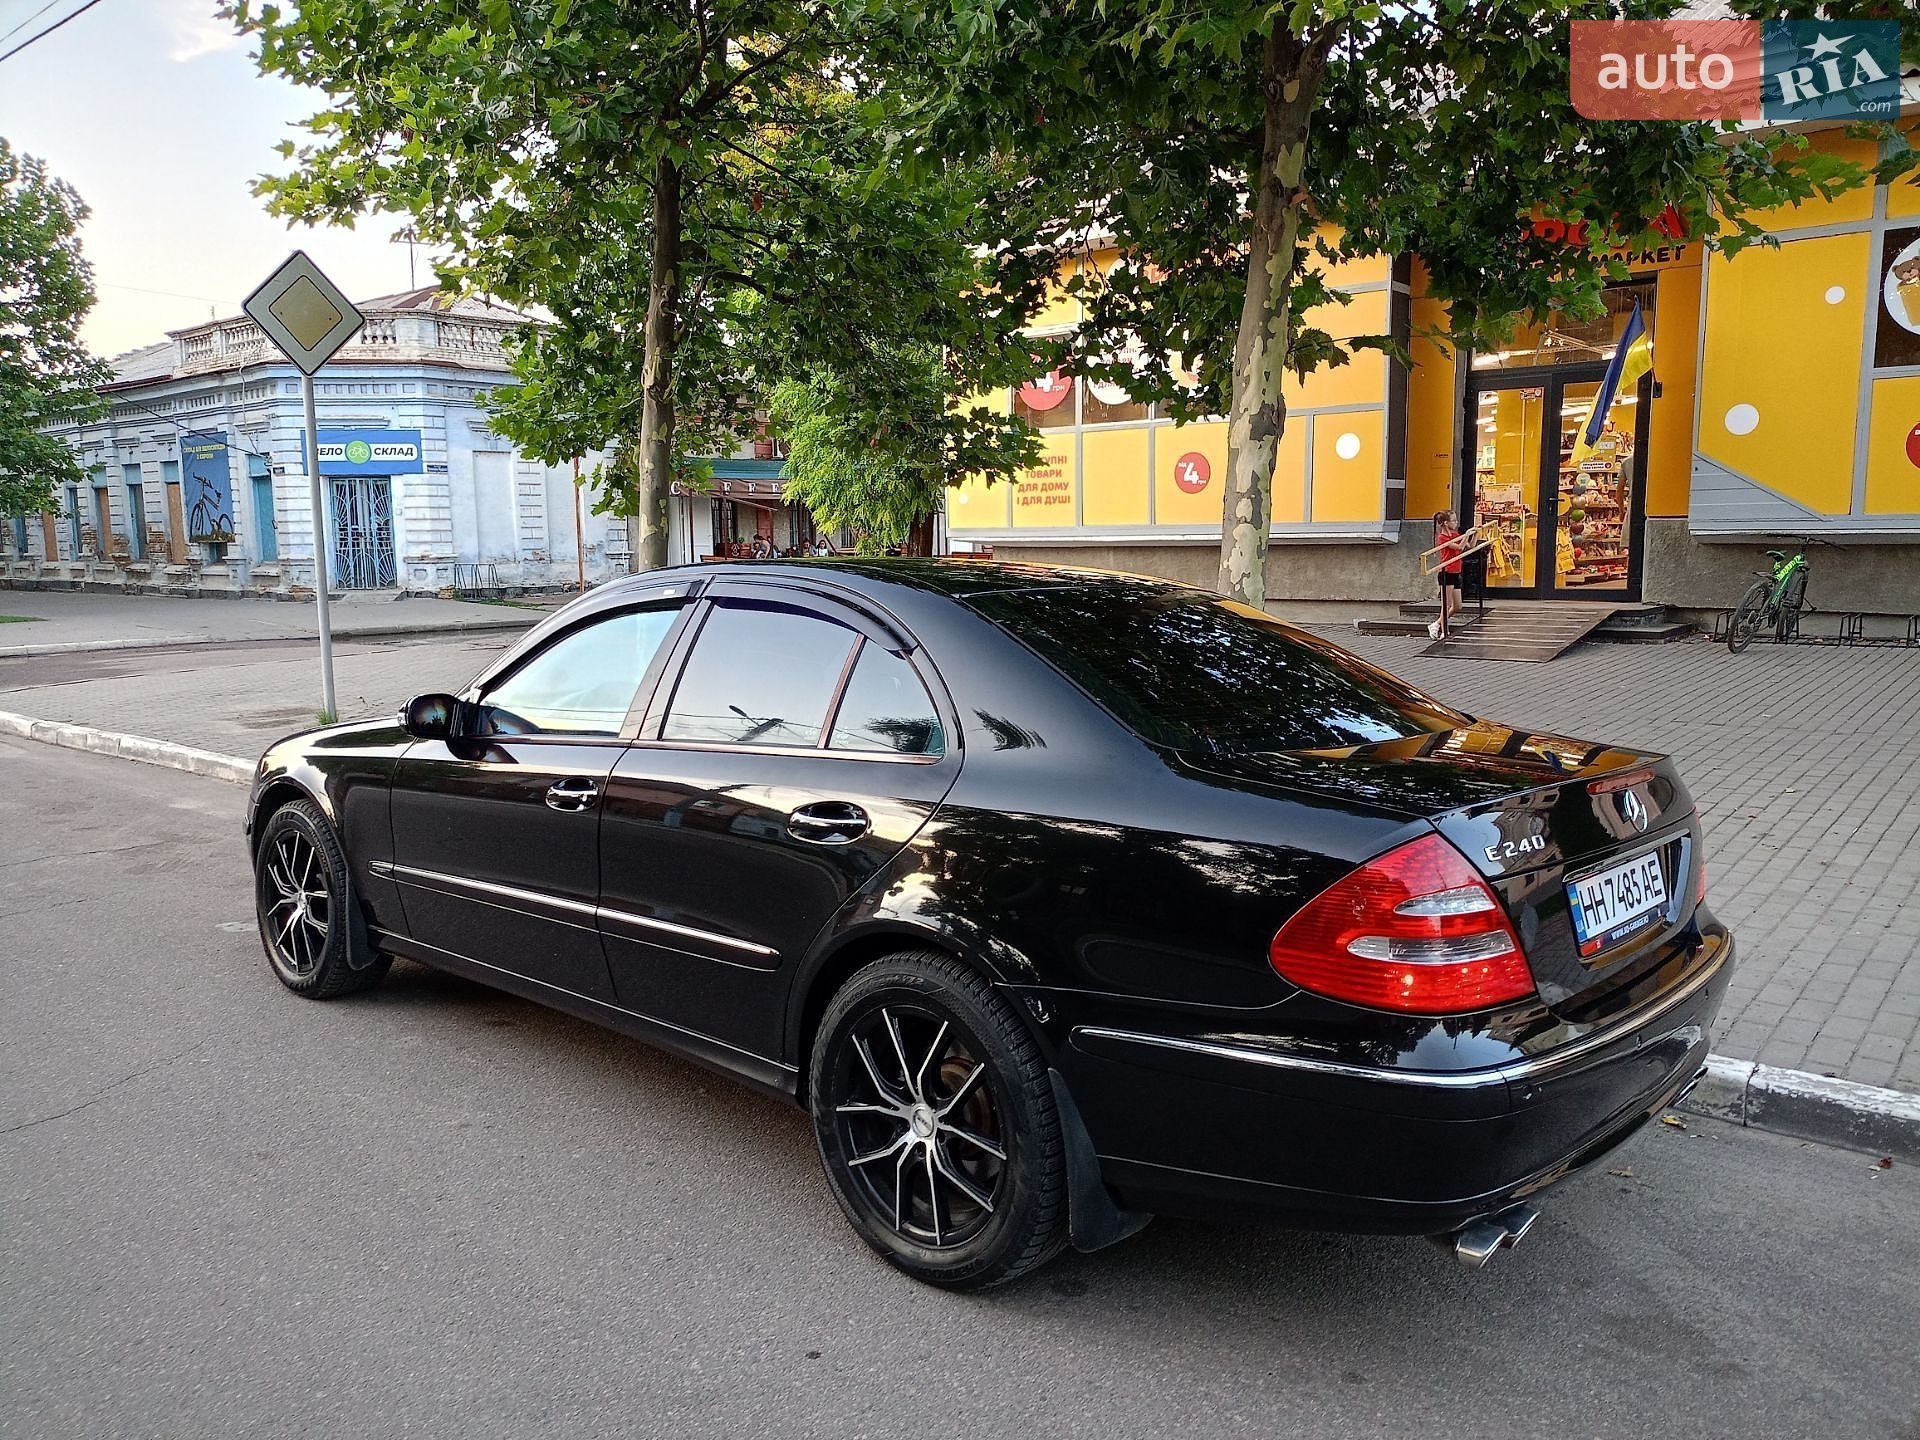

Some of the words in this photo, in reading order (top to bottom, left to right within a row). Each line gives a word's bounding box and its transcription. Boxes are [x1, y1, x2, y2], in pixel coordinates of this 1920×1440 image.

[374, 447, 414, 457] СКЛАД
[1025, 469, 1062, 479] ТОВАРИ
[1183, 462, 1200, 485] 4
[1018, 483, 1038, 493] ДЛЯ
[1040, 482, 1069, 493] ДОМУ
[1022, 496, 1042, 506] ДЛЯ
[1044, 495, 1071, 506] ДУШІ
[1484, 845, 1502, 862] E
[1502, 834, 1545, 858] 240
